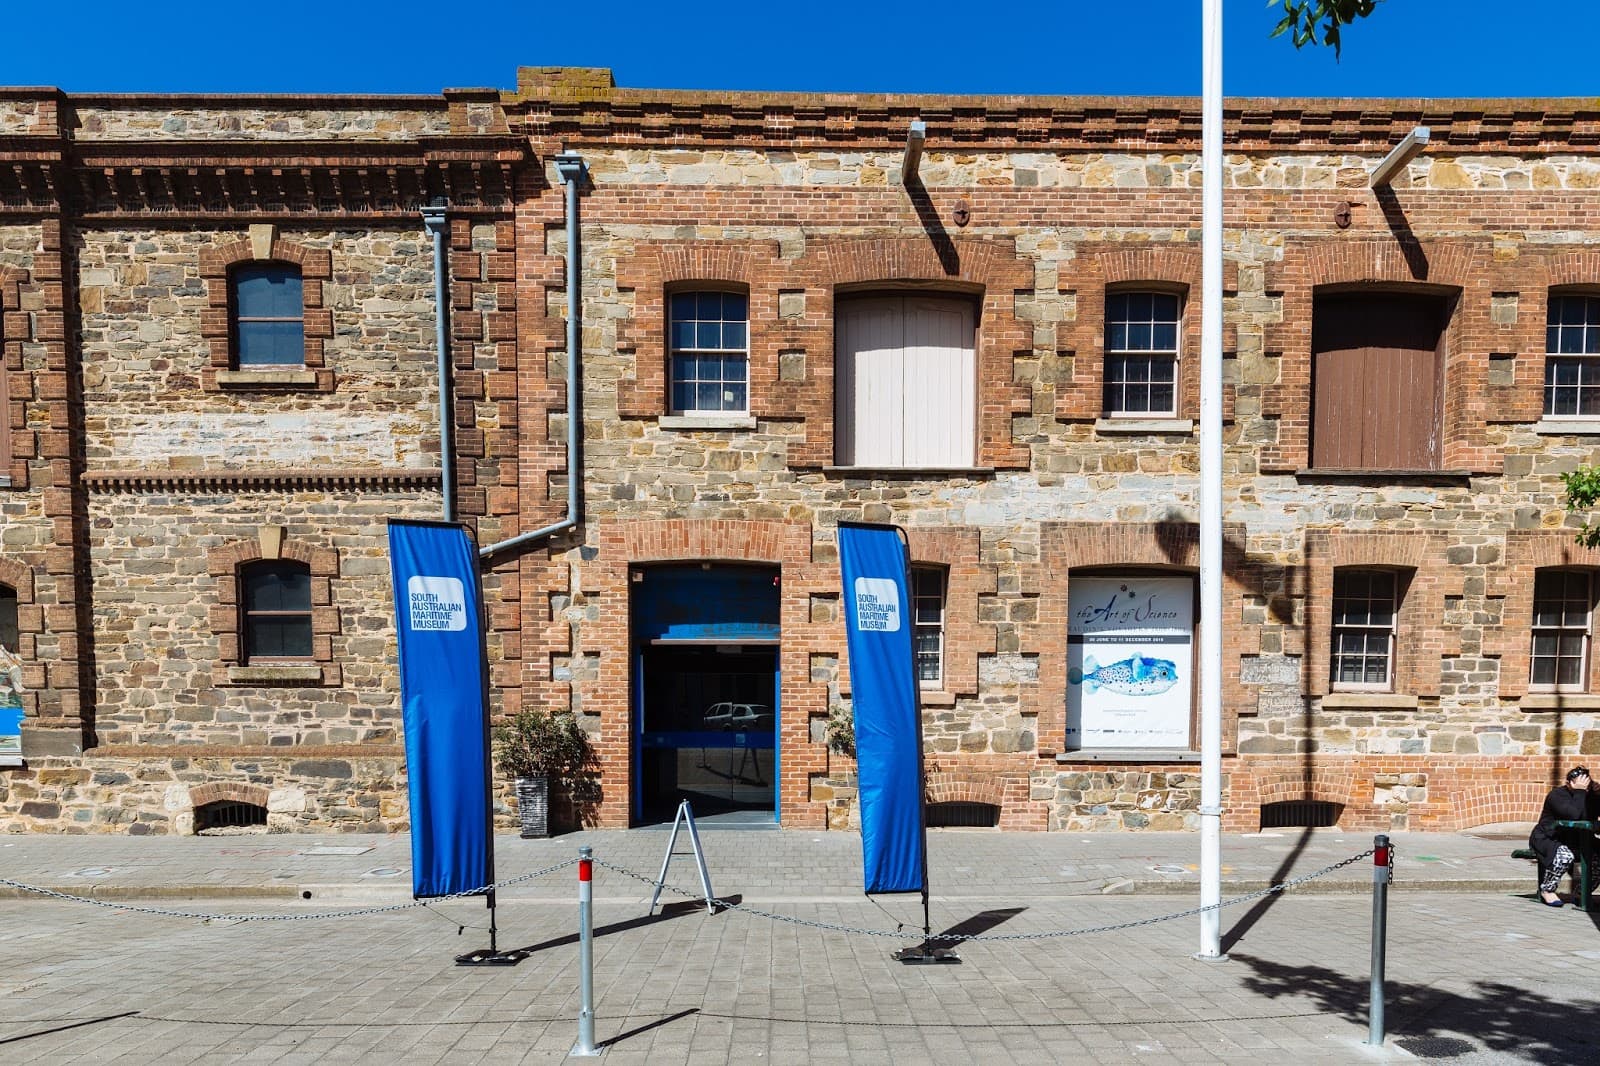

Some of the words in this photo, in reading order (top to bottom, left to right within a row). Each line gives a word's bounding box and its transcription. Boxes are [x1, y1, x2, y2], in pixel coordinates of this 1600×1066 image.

[411, 593, 438, 602] SOUTH
[858, 594, 878, 603] SOUTH
[412, 602, 462, 612] AUSTRALIAN
[859, 603, 896, 612] AUSTRALIAN
[1076, 605, 1093, 618] the
[1084, 594, 1118, 624] Art
[1135, 595, 1177, 622] Science
[413, 611, 452, 620] MARITIME
[860, 612, 889, 621] MARITIME
[1119, 608, 1135, 623] of
[413, 620, 450, 629] MUSEUM
[860, 620, 887, 629] MUSEUM
